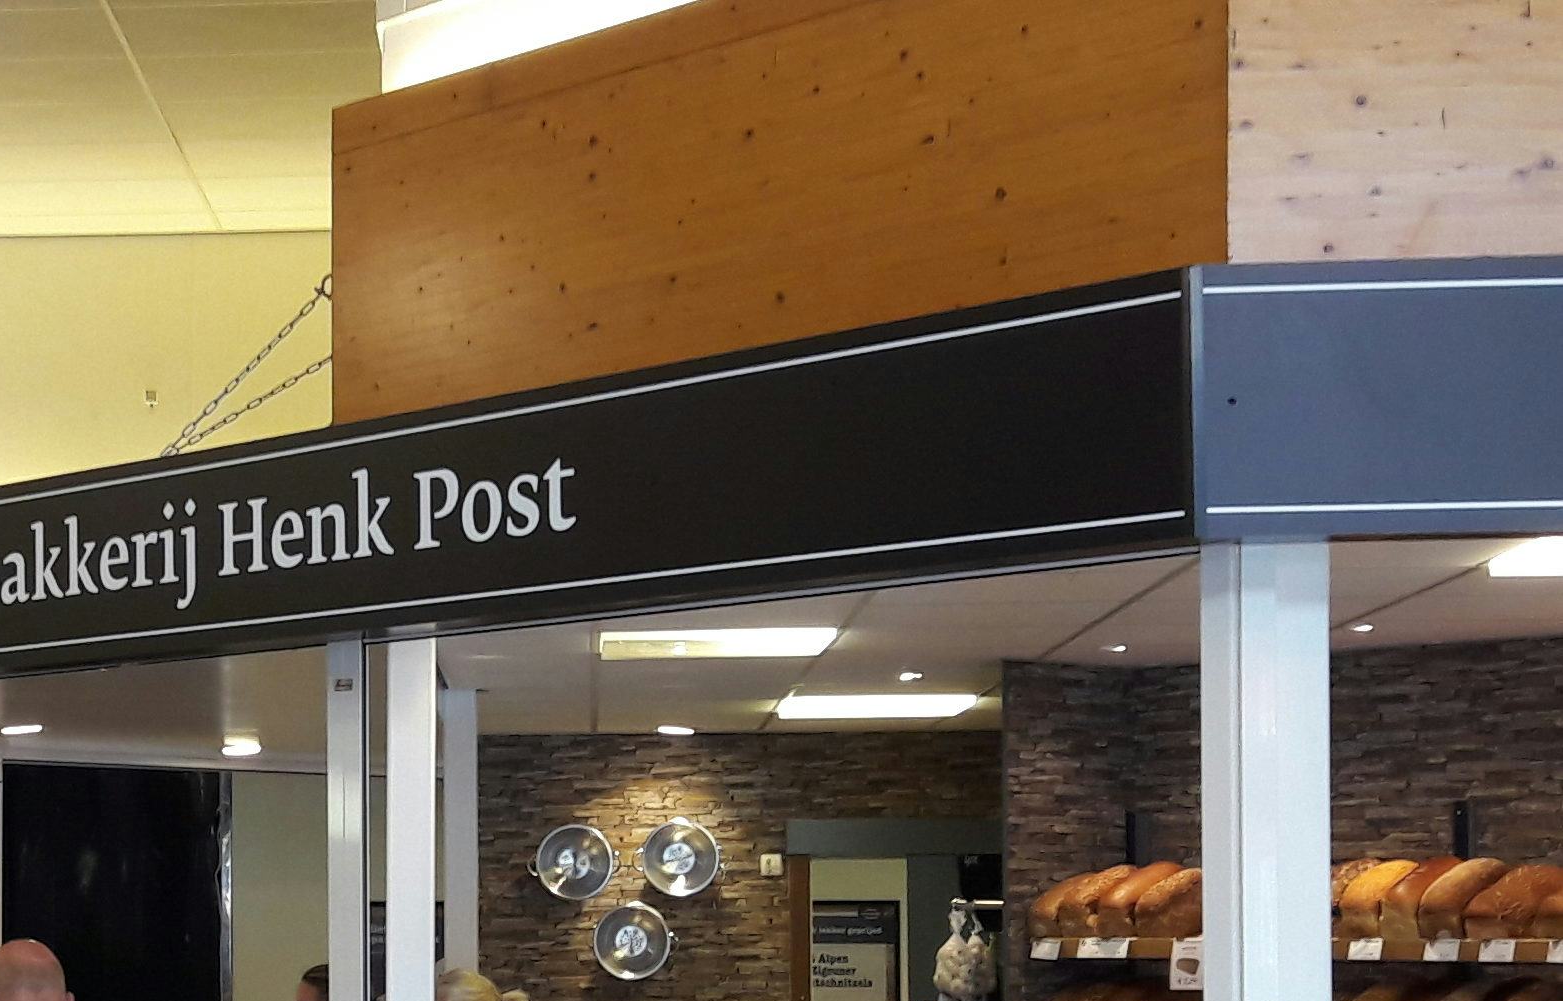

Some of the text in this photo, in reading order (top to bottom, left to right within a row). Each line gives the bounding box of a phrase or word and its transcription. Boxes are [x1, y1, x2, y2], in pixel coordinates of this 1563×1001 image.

[218, 467, 394, 577] Henk
[413, 457, 577, 551] Post
[818, 953, 849, 966] Alpen
